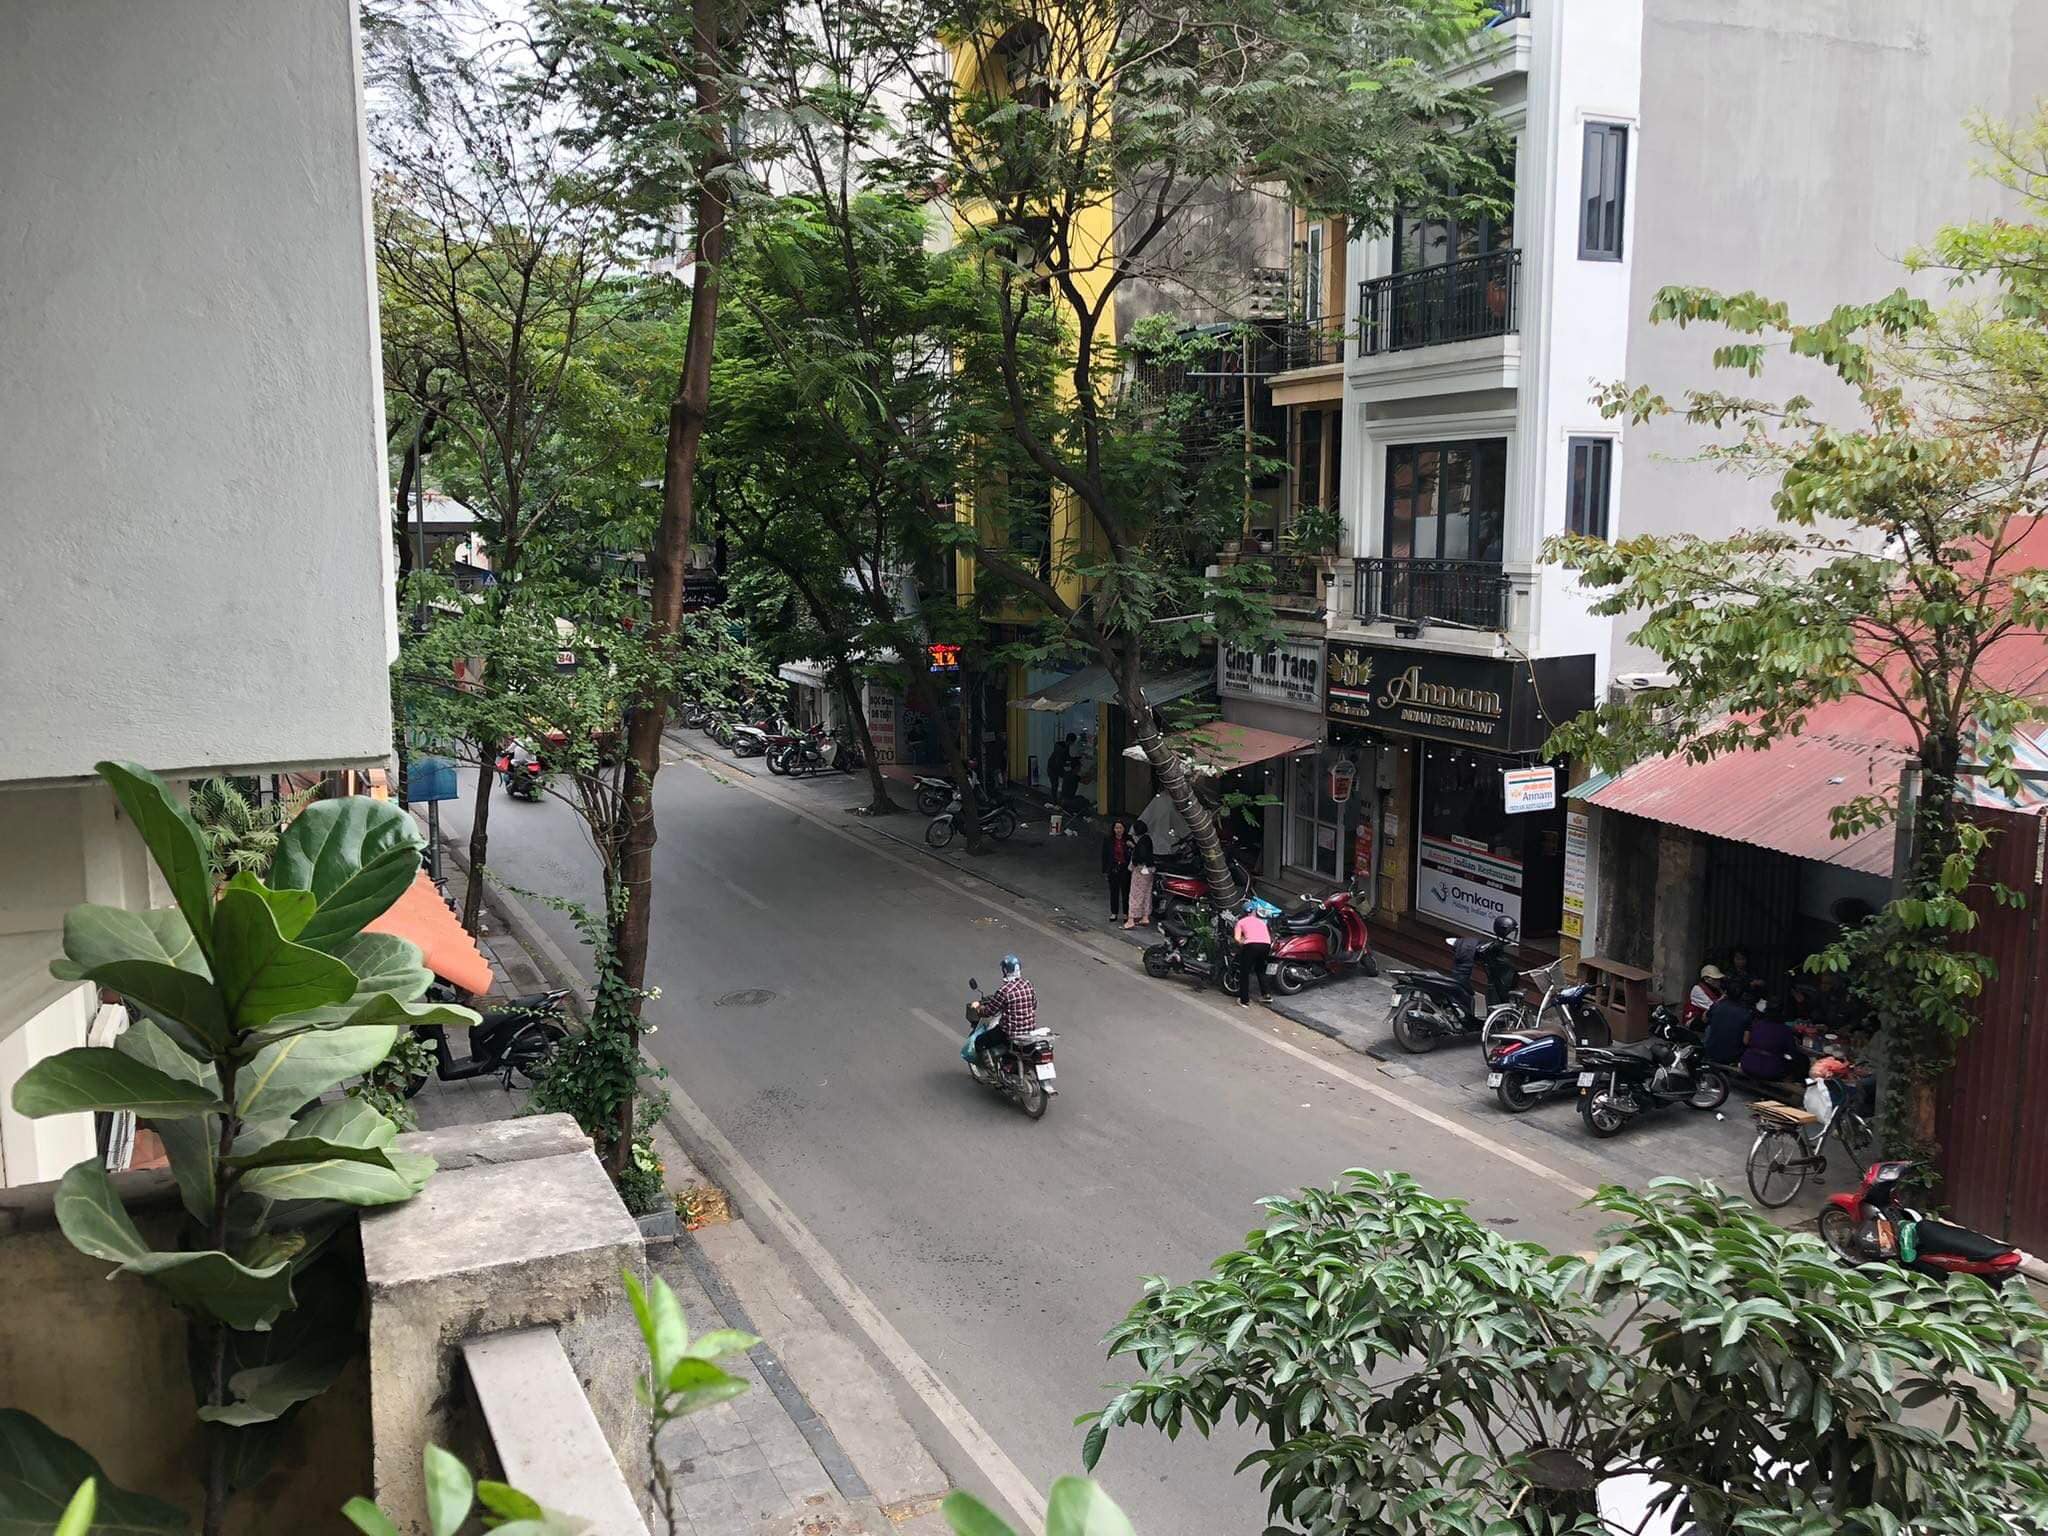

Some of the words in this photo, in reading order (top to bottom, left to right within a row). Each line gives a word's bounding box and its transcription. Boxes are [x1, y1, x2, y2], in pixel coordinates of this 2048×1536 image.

[1281, 653, 1317, 684] Tang
[1377, 665, 1502, 714] Annam
[1401, 708, 1432, 726] INDIAN
[1432, 712, 1495, 735] RESTAURANT
[1522, 791, 1553, 801] Annam
[1454, 856, 1476, 871] Indian
[1478, 866, 1517, 882] Restaurant
[1451, 886, 1504, 913] Omkara
